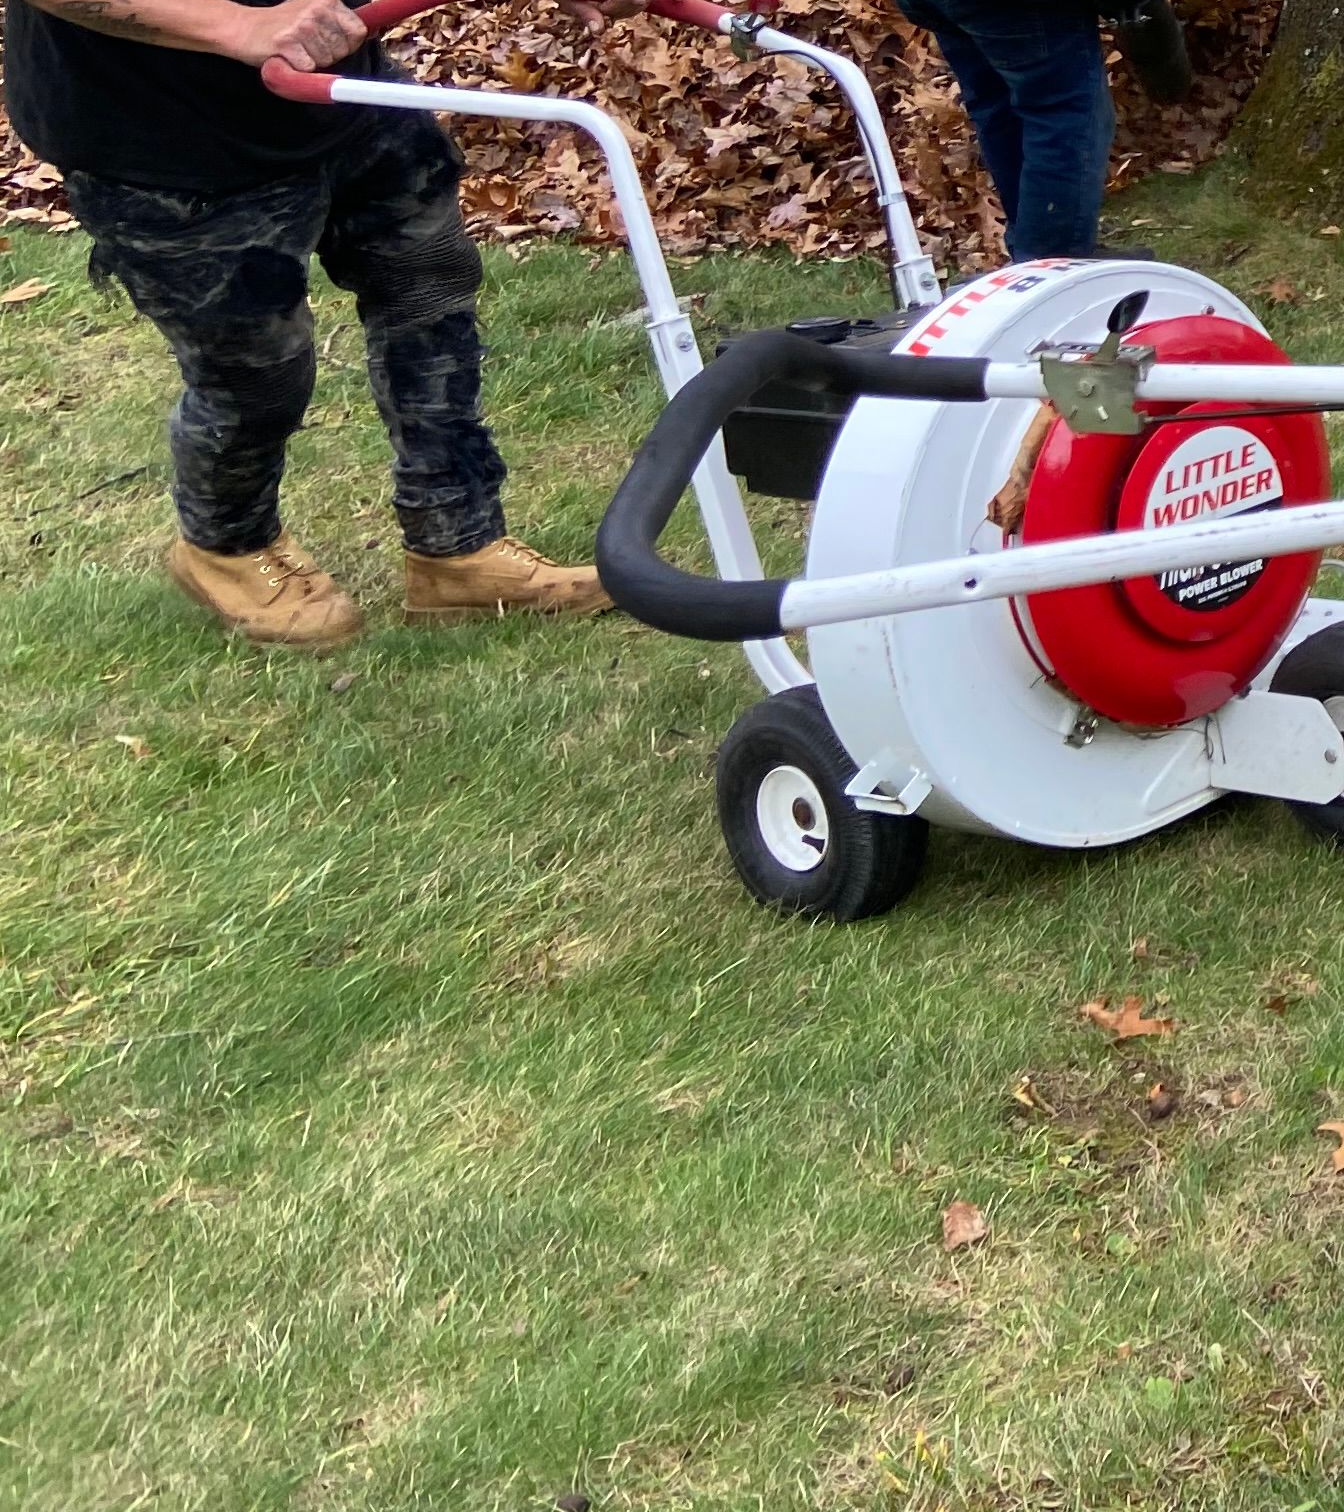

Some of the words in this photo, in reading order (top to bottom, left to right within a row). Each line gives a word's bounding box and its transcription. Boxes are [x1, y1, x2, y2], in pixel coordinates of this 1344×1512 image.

[1165, 442, 1257, 495] LITTLE
[1153, 468, 1273, 529] WONDER
[1178, 577, 1218, 602] POWER
[1220, 558, 1263, 584] BLOWER
